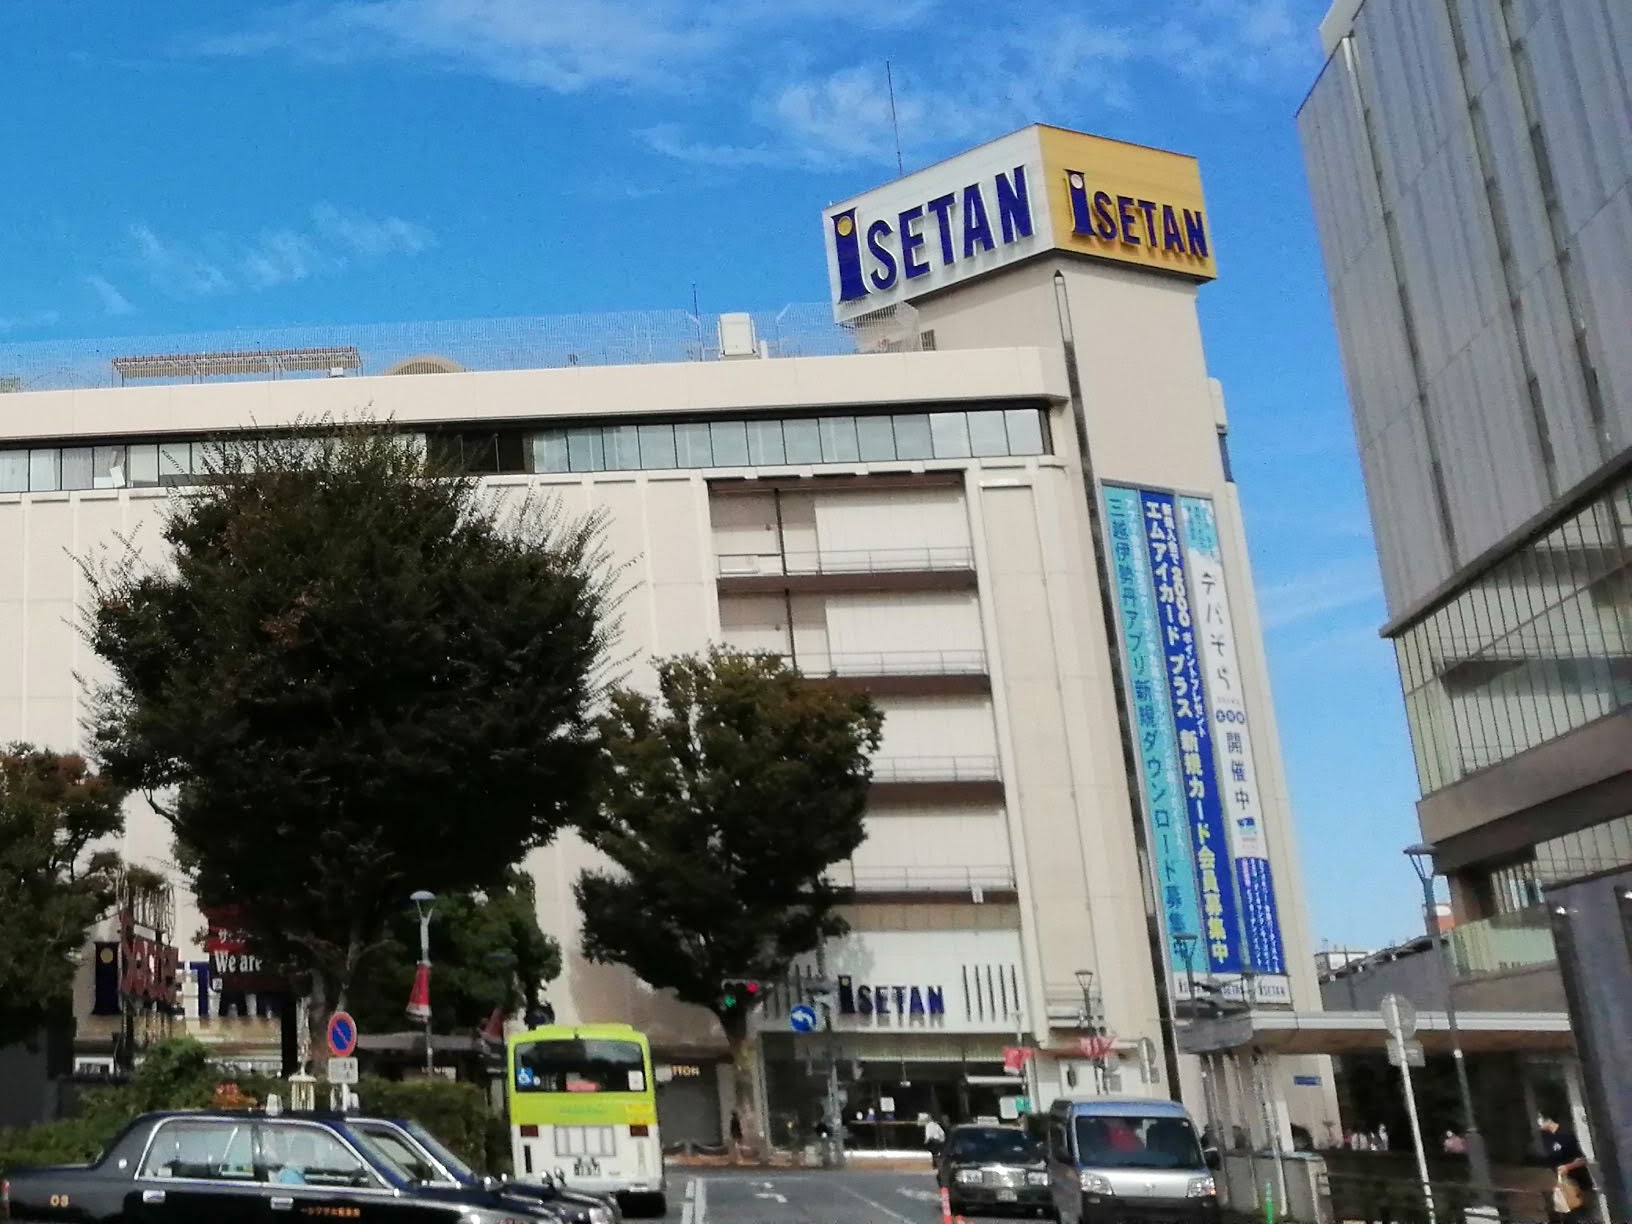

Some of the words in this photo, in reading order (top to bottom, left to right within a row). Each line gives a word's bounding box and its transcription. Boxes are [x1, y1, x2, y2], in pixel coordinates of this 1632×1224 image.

[1169, 653, 1194, 718] プラス
[1226, 732, 1250, 811] 開催中
[215, 950, 238, 974] We
[838, 975, 945, 1015] ISETAN
